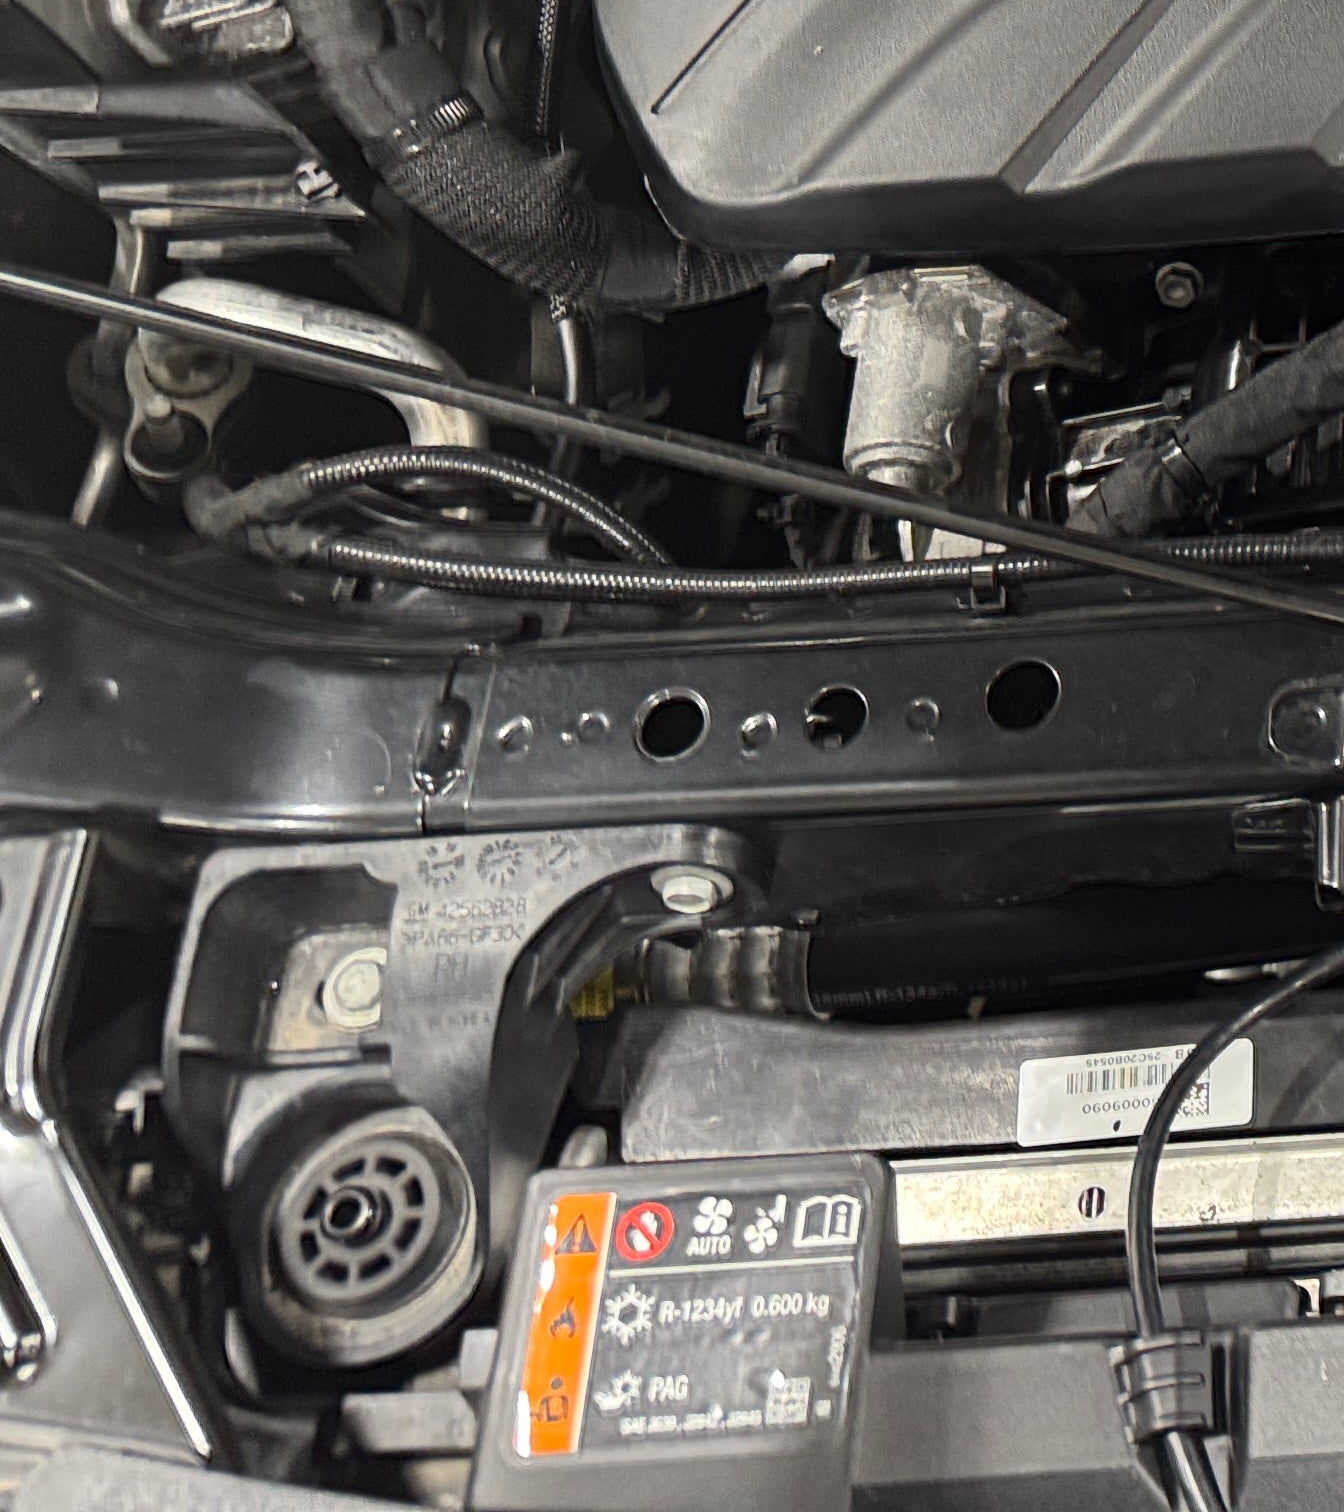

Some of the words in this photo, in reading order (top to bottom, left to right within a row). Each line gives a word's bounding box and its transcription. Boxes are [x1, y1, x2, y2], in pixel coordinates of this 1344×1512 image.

[687, 1237, 732, 1256] AUTO
[659, 1297, 744, 1325] R-1234yf
[752, 1293, 803, 1318] 0.600
[805, 1292, 829, 1319] kg
[648, 1376, 689, 1402] PAG
